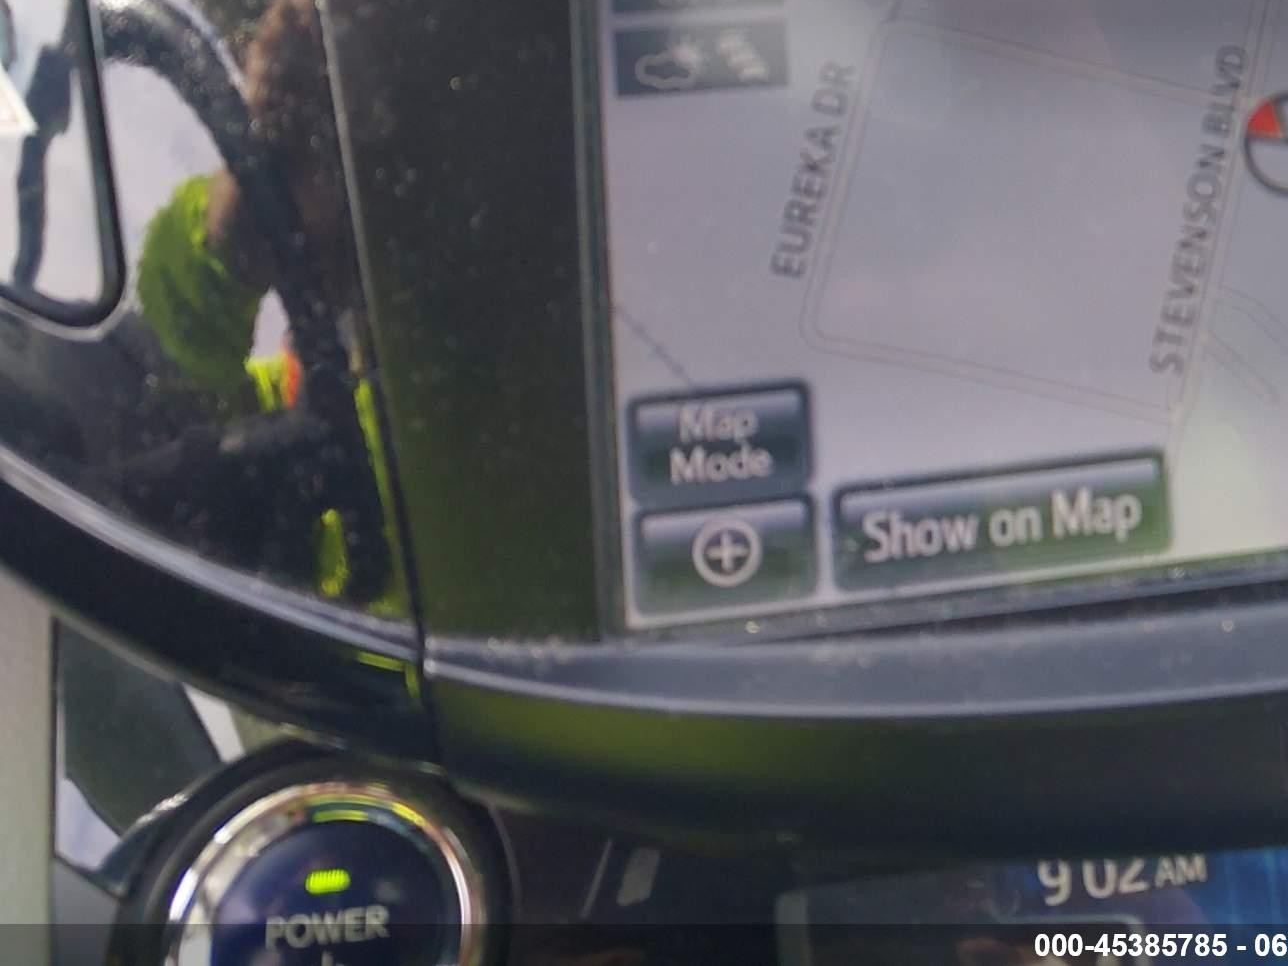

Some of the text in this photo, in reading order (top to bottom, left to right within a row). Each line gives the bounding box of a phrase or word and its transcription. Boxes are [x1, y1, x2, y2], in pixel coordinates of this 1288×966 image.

[770, 57, 856, 279] EUREKA DR
[1150, 44, 1247, 375] STEVENSON BLVD
[679, 405, 757, 445] Map
[669, 440, 773, 485] Mode
[862, 486, 1142, 564] Show on Map
[1154, 853, 1207, 889] AM
[265, 904, 391, 951] POWER
